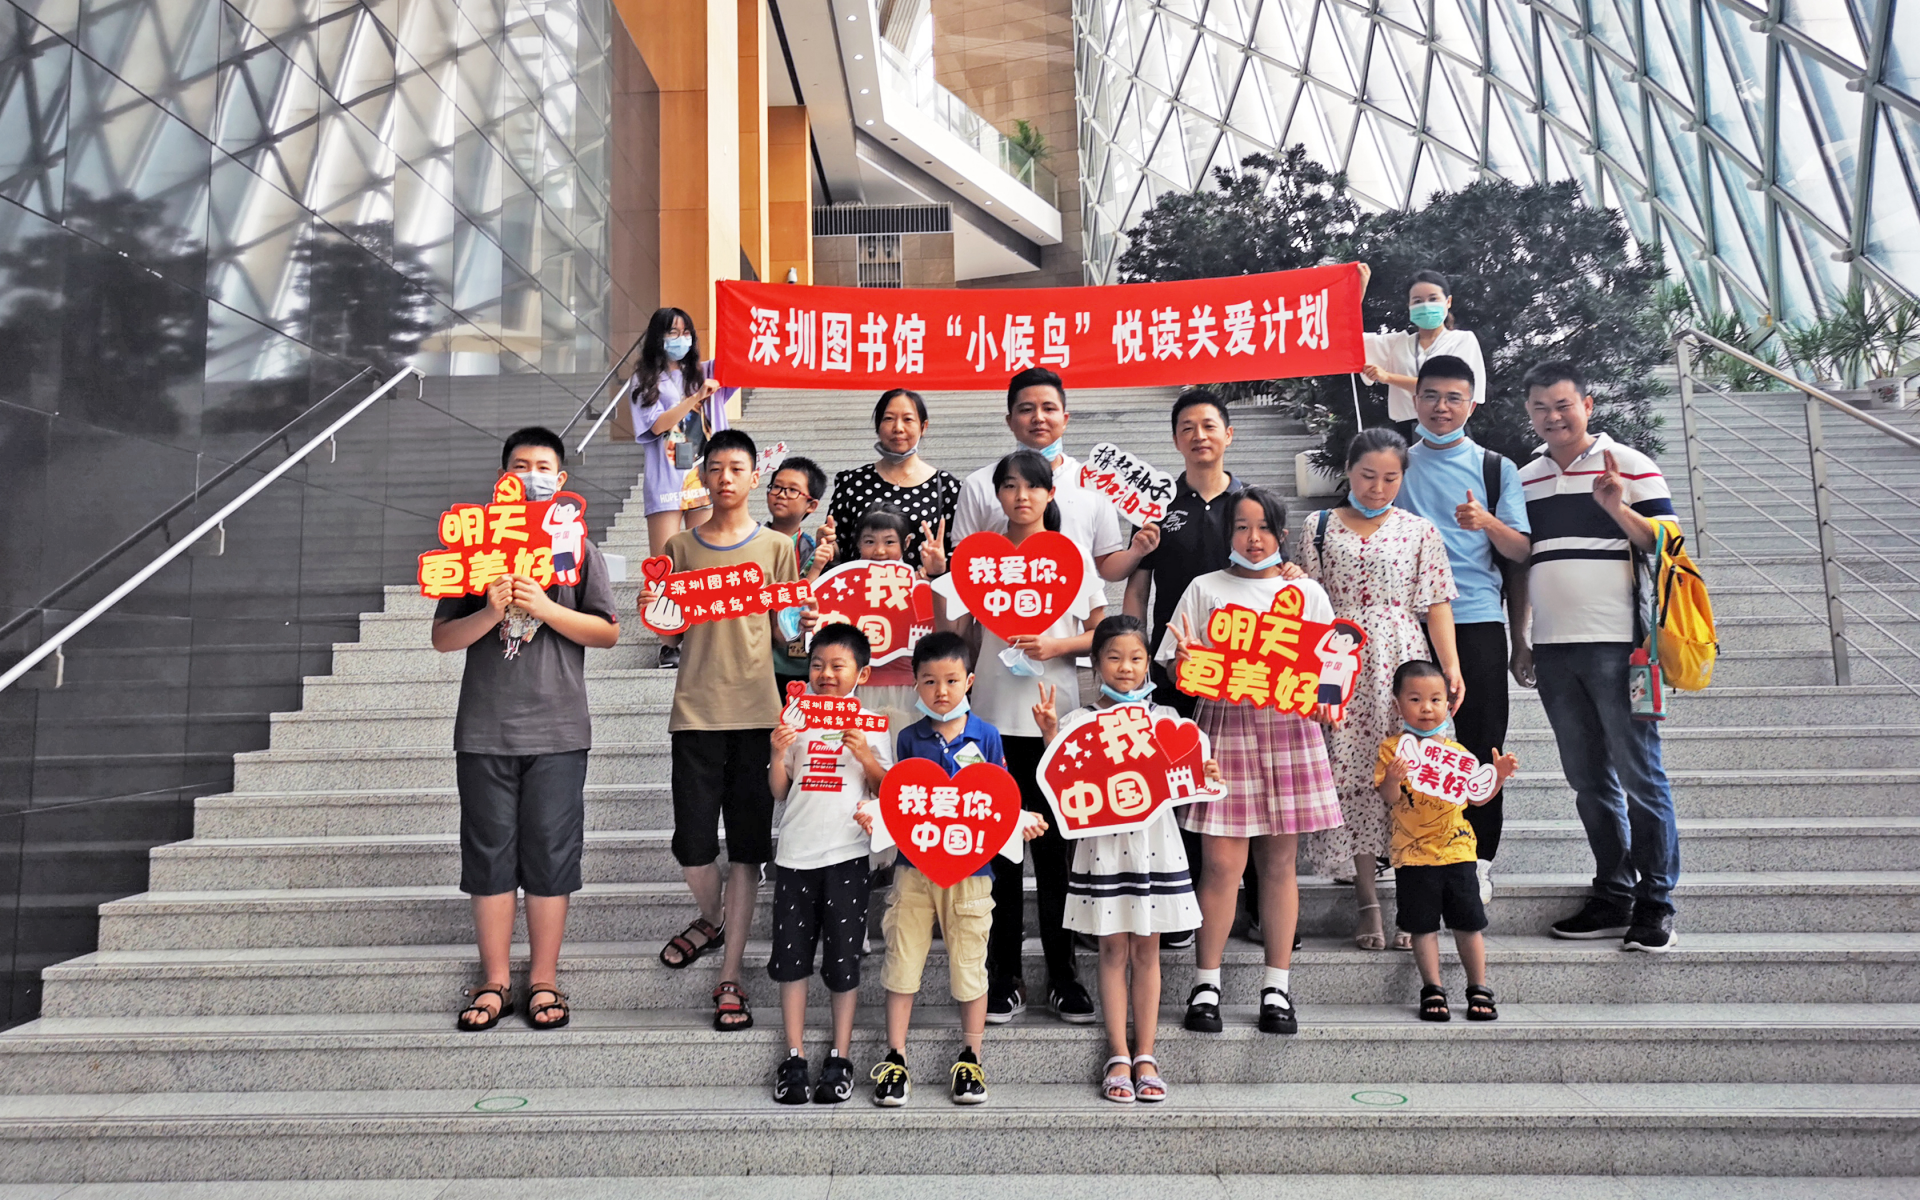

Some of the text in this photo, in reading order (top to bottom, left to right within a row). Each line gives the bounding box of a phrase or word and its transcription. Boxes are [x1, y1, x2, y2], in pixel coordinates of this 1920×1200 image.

[1093, 446, 1172, 501] 撸起袖子
[660, 492, 680, 503] HOPE
[442, 505, 529, 547] 明天
[421, 546, 556, 596] 更美好
[670, 568, 760, 596] 深圳图书馆
[865, 564, 911, 611] 我
[1210, 609, 1303, 662] 明天
[1179, 649, 1320, 715] 更美好
[799, 700, 858, 713] 深圳图书馆
[1098, 707, 1157, 765] 我
[1417, 763, 1467, 798] 美好
[1424, 745, 1476, 775] 明天更
[1060, 771, 1152, 826] 中国
